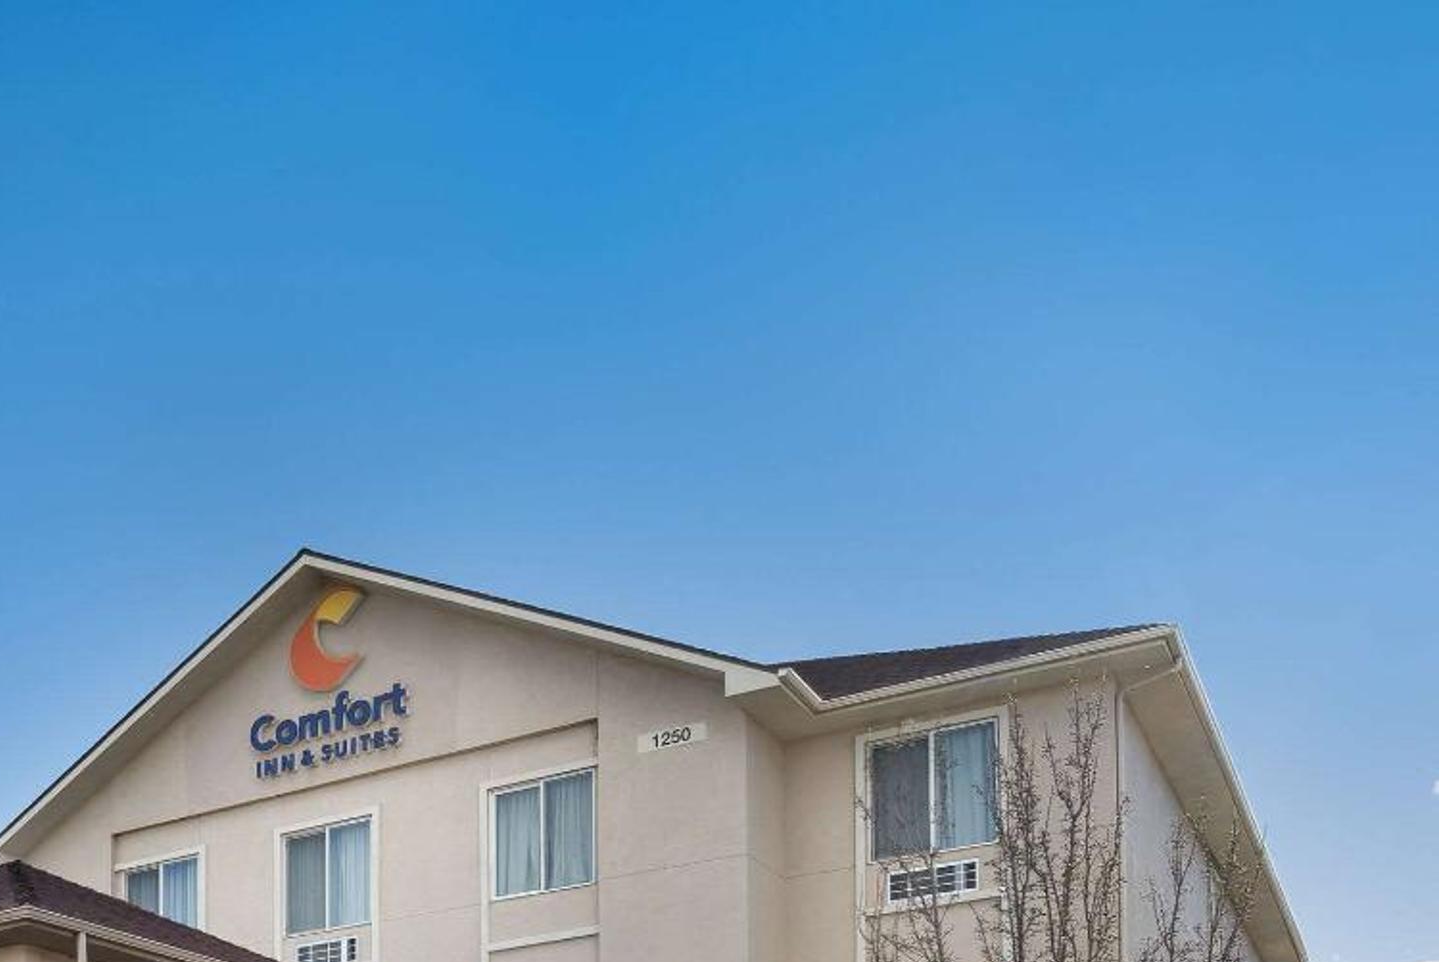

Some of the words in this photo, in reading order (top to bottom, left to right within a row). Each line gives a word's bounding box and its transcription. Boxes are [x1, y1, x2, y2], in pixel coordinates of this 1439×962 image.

[250, 683, 407, 752] Comfort
[652, 726, 691, 748] 1250
[257, 754, 295, 779] INN
[301, 750, 315, 767] &
[321, 727, 400, 761] SUITES
